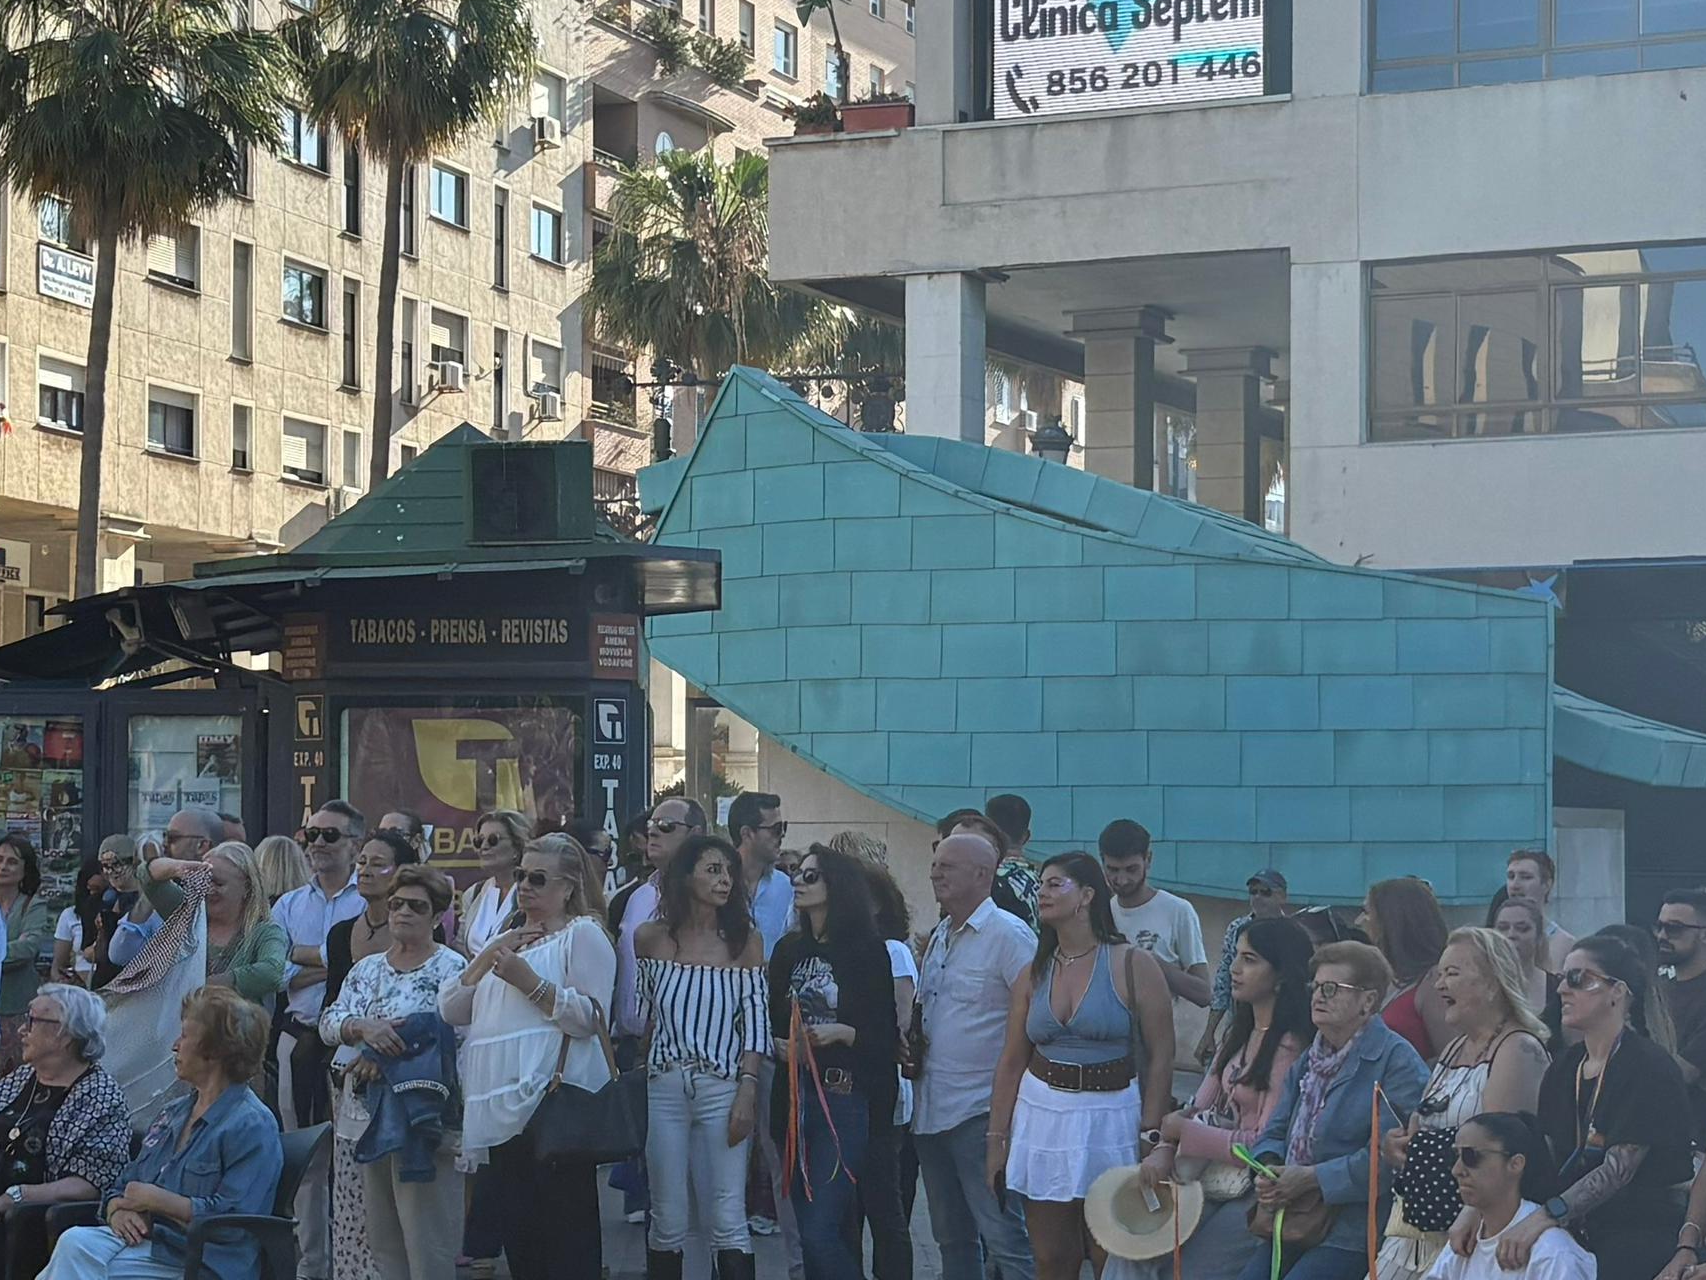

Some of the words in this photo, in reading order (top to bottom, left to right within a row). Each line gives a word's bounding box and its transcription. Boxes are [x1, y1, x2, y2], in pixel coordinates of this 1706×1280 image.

[1046, 68, 1110, 97] 856
[1121, 58, 1181, 89] 201
[1195, 50, 1262, 81] 446
[67, 259, 93, 281] LEVY
[350, 619, 416, 644] TABACOS
[430, 619, 487, 644] PRENSA
[501, 619, 569, 644] REVISTAS
[594, 754, 610, 770] EXP.
[612, 754, 622, 770] 40
